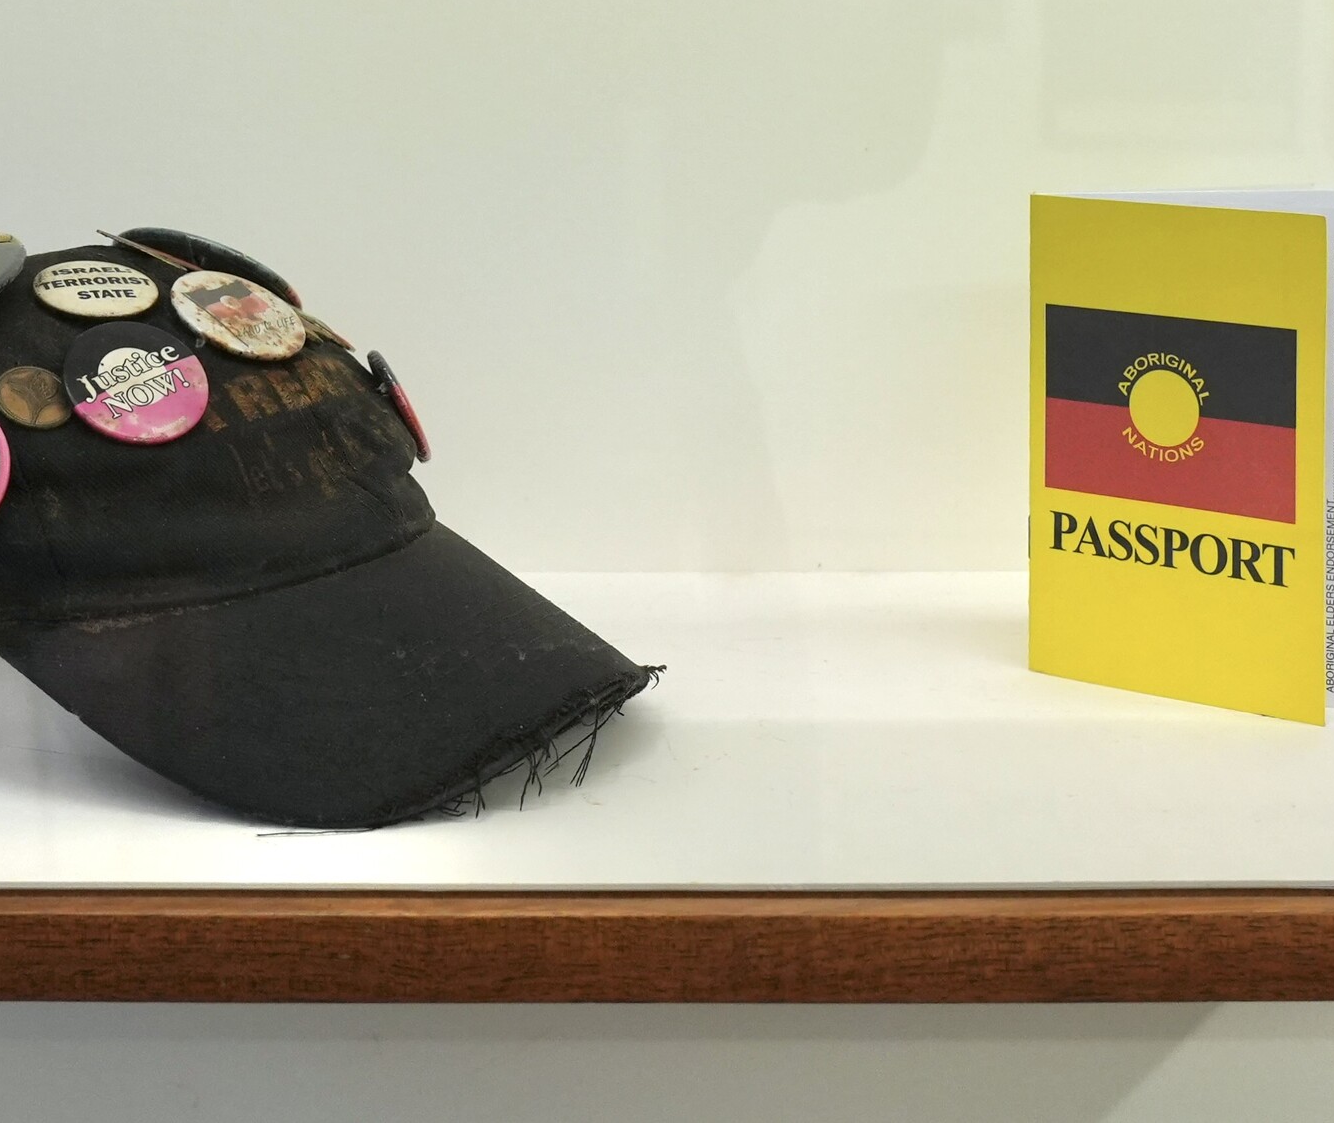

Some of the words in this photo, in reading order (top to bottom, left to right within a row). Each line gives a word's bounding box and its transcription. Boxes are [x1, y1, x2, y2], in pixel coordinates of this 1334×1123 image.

[40, 277, 150, 290] TERRORIST
[77, 289, 137, 300] STATE
[76, 345, 180, 403] Justice
[101, 368, 191, 419] NOW!
[1117, 352, 1210, 406] ABORIGINAL
[1122, 426, 1204, 462] NATIONS
[1049, 510, 1295, 588] PASSPORT
[1326, 585, 1334, 626] ELDERS
[1326, 629, 1334, 693] ABORIGINAL
